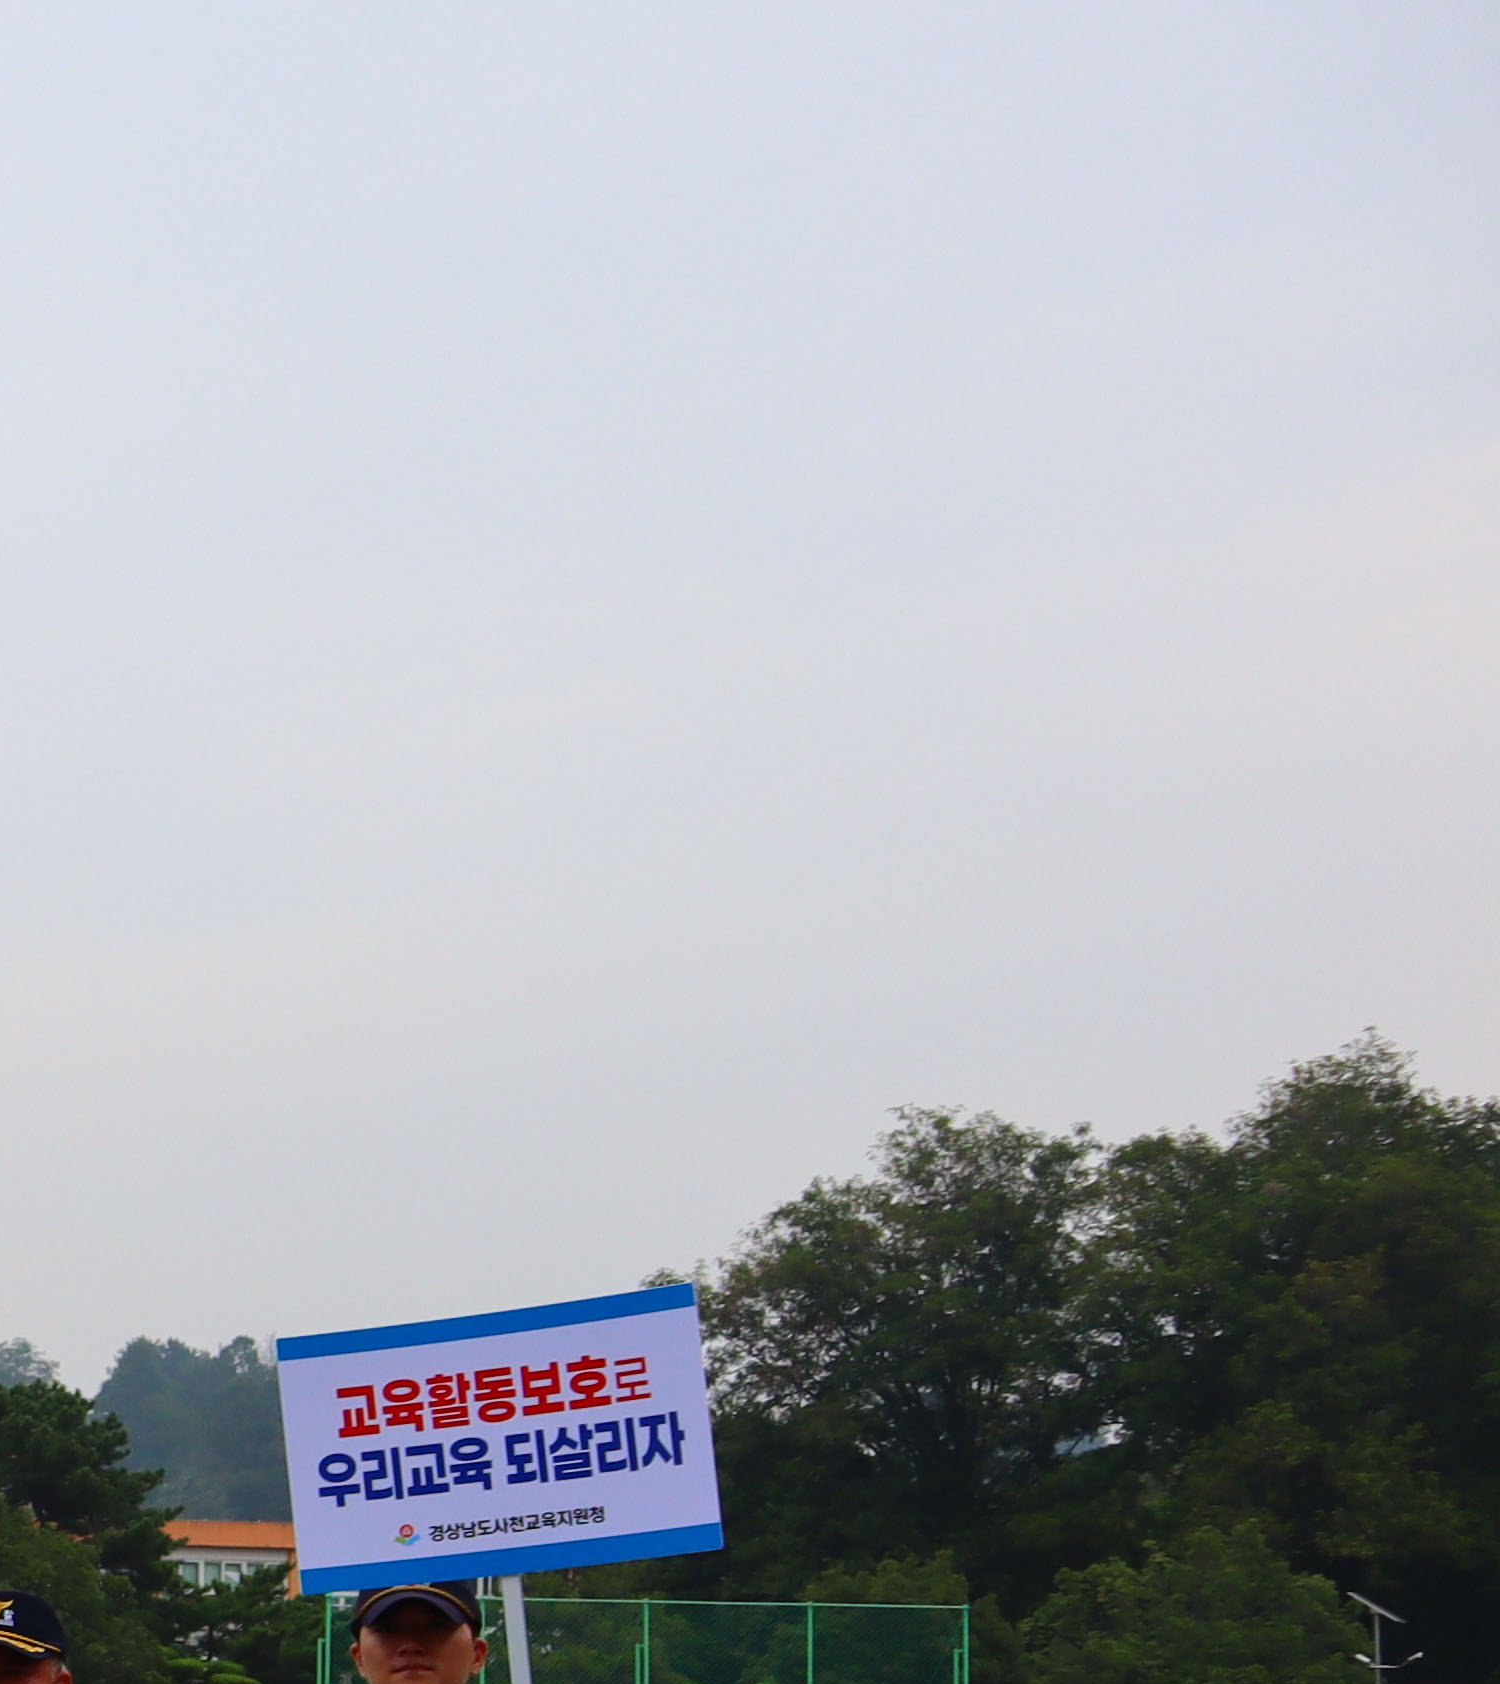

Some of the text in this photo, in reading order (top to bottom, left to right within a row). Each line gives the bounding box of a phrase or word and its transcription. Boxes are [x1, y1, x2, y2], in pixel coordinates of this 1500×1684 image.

[336, 1355, 652, 1439] 교육활동보호로
[317, 1411, 686, 1508] 우리교육 되살리자
[429, 1506, 606, 1542] 경상남도사천교육지원청
